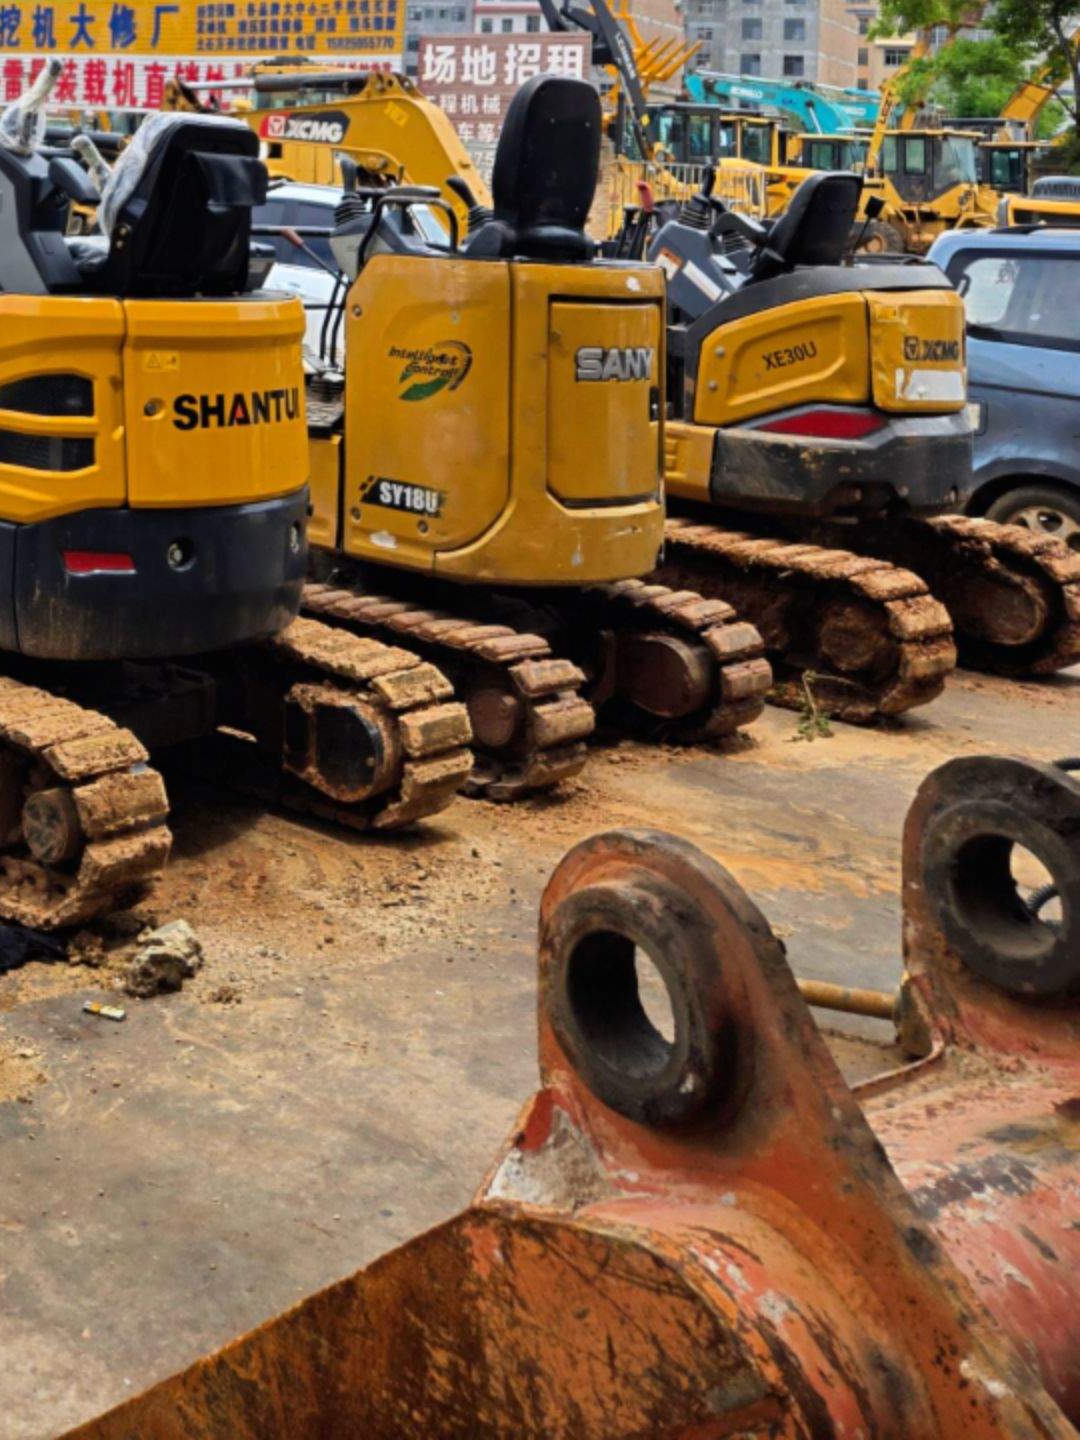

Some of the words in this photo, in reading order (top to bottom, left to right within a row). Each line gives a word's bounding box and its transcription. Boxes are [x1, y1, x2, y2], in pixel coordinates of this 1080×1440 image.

[422, 44, 583, 86] 场地招租
[425, 93, 501, 115] 程机械
[284, 120, 344, 143] XCMG
[575, 346, 654, 383] SANY
[761, 341, 818, 372] XE30U
[379, 481, 439, 515] SY18U
